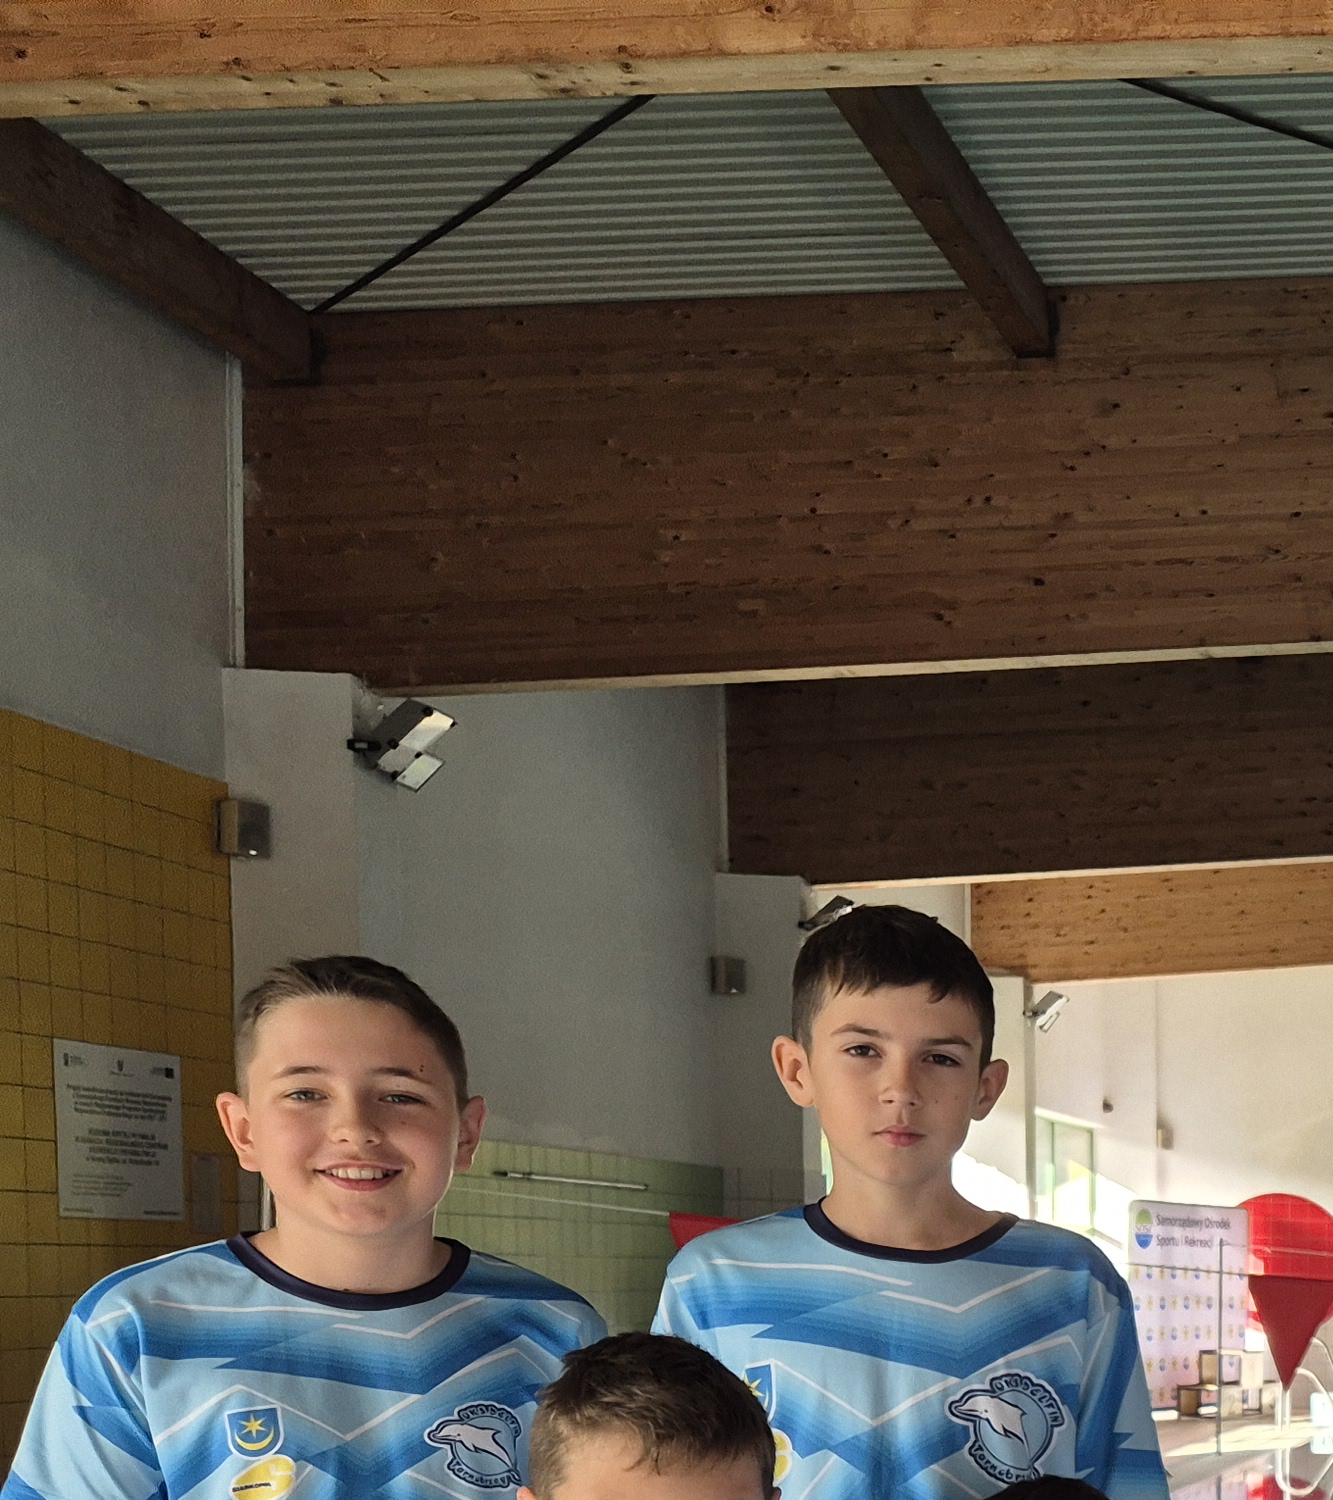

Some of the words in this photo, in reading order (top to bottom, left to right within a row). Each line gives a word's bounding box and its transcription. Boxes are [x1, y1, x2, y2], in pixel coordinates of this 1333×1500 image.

[1204, 1217, 1232, 1230] Ośrodek
[1156, 1234, 1180, 1249] Sportu
[996, 1377, 1018, 1391] UKS
[461, 1406, 487, 1419] UKS
